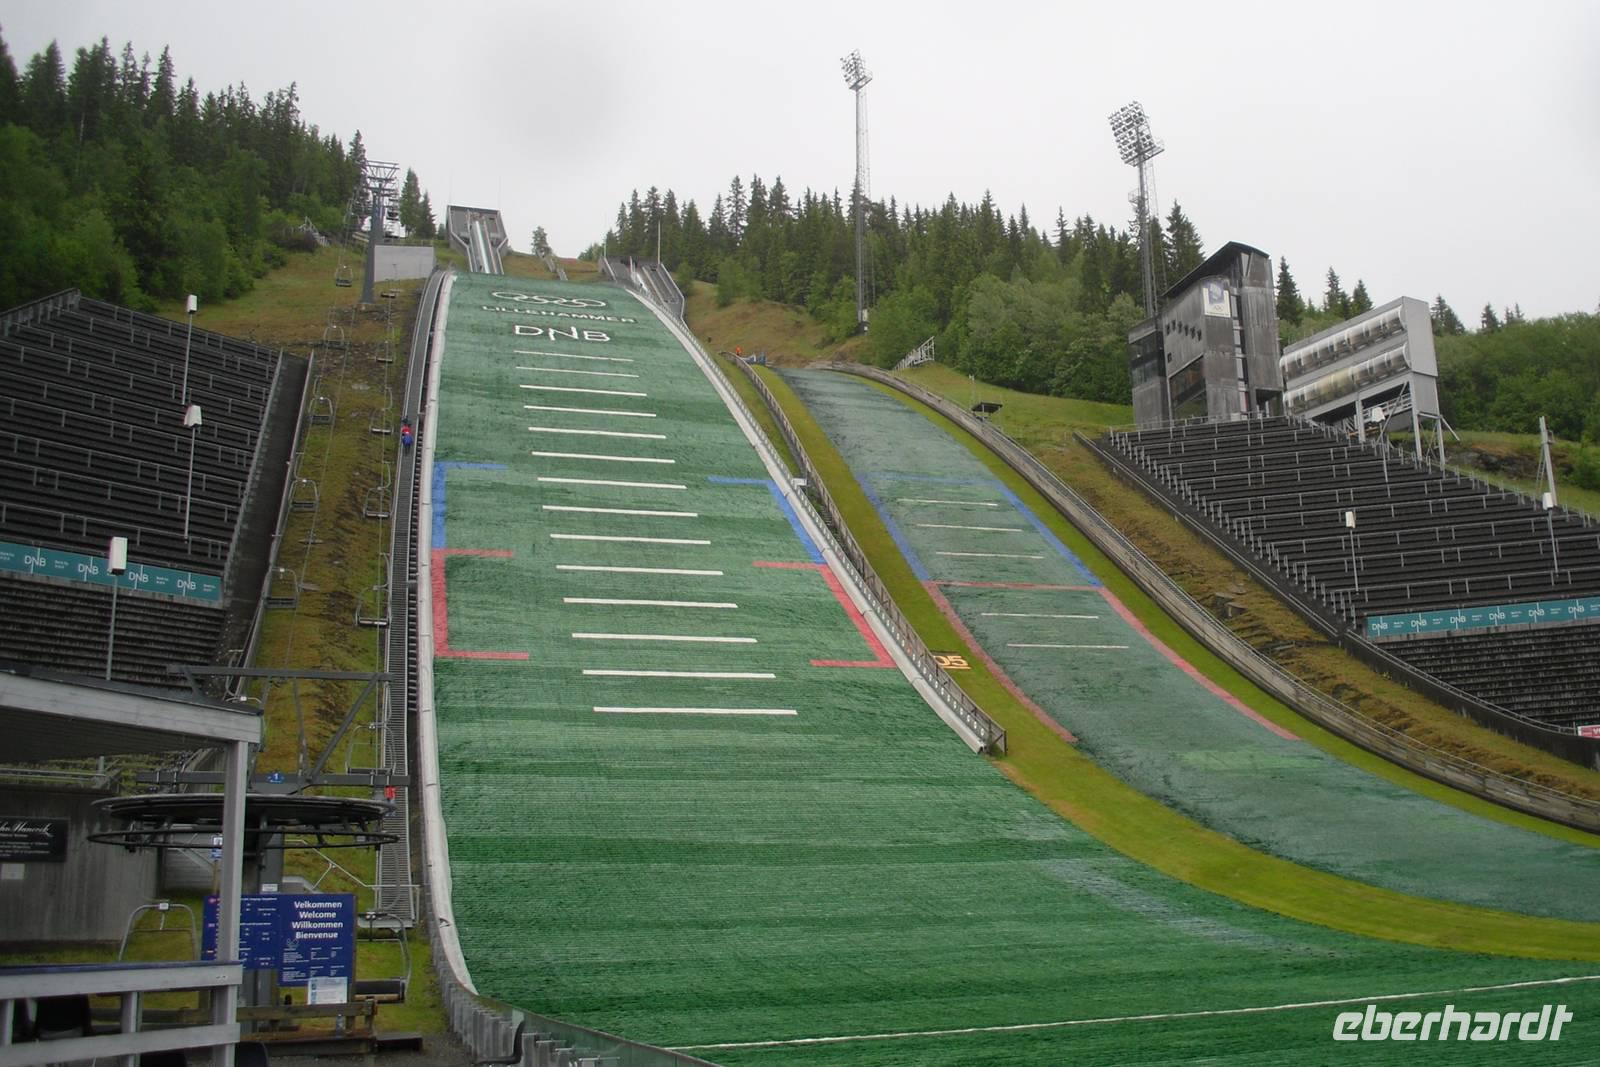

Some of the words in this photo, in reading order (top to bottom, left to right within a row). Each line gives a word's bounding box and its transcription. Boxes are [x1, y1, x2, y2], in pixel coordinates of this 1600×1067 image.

[482, 305, 636, 323] LILLEHAMMER
[514, 325, 611, 341] DNB
[294, 901, 342, 909] Velkommen
[292, 921, 343, 929] Willkommen
